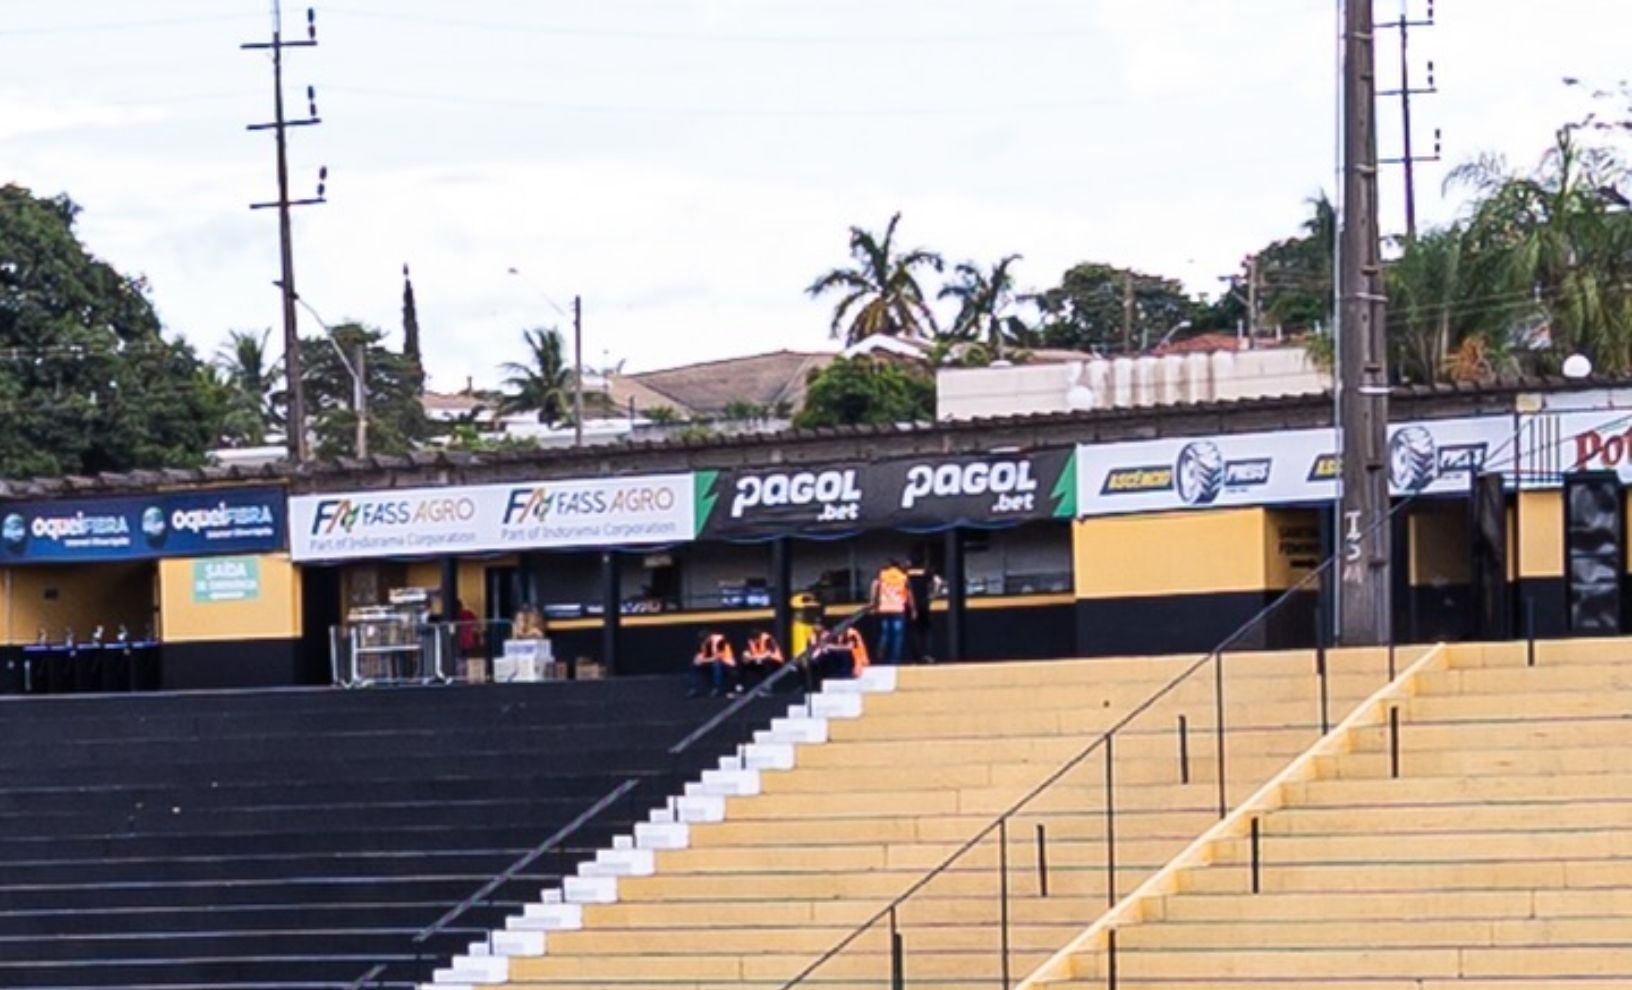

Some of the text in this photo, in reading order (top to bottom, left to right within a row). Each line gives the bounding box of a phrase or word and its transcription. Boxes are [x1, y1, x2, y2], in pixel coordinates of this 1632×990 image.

[1575, 427, 1632, 472] Pot
[362, 500, 410, 525] FASS
[412, 497, 475, 523] AGRO
[557, 489, 607, 515] FASS
[609, 487, 675, 514] AGRO
[310, 537, 334, 553] Part
[407, 529, 477, 547] Corporation
[501, 526, 524, 542] Part
[602, 519, 677, 536] Corporation
[205, 561, 247, 579] SAÍDA
